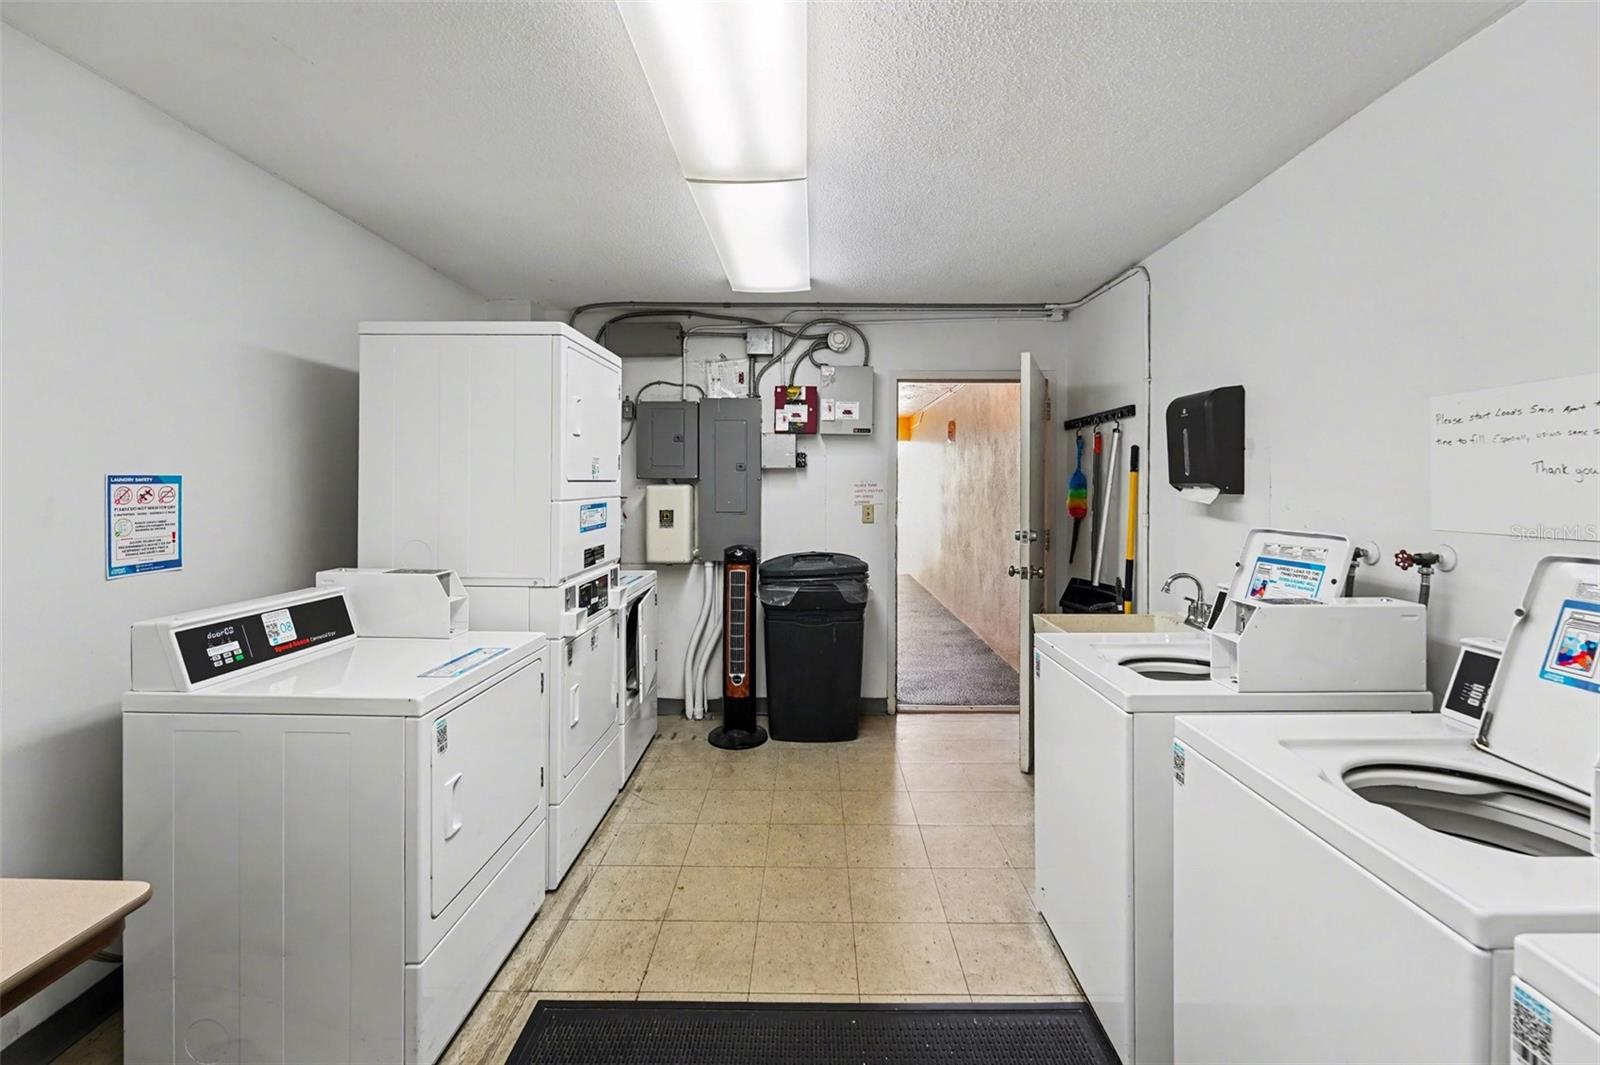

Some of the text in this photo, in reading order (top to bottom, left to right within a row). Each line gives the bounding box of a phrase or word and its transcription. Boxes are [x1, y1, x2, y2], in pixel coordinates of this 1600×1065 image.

[1435, 412, 1464, 424] Please
[1531, 460, 1569, 475] Thank
[280, 621, 293, 633] 08
